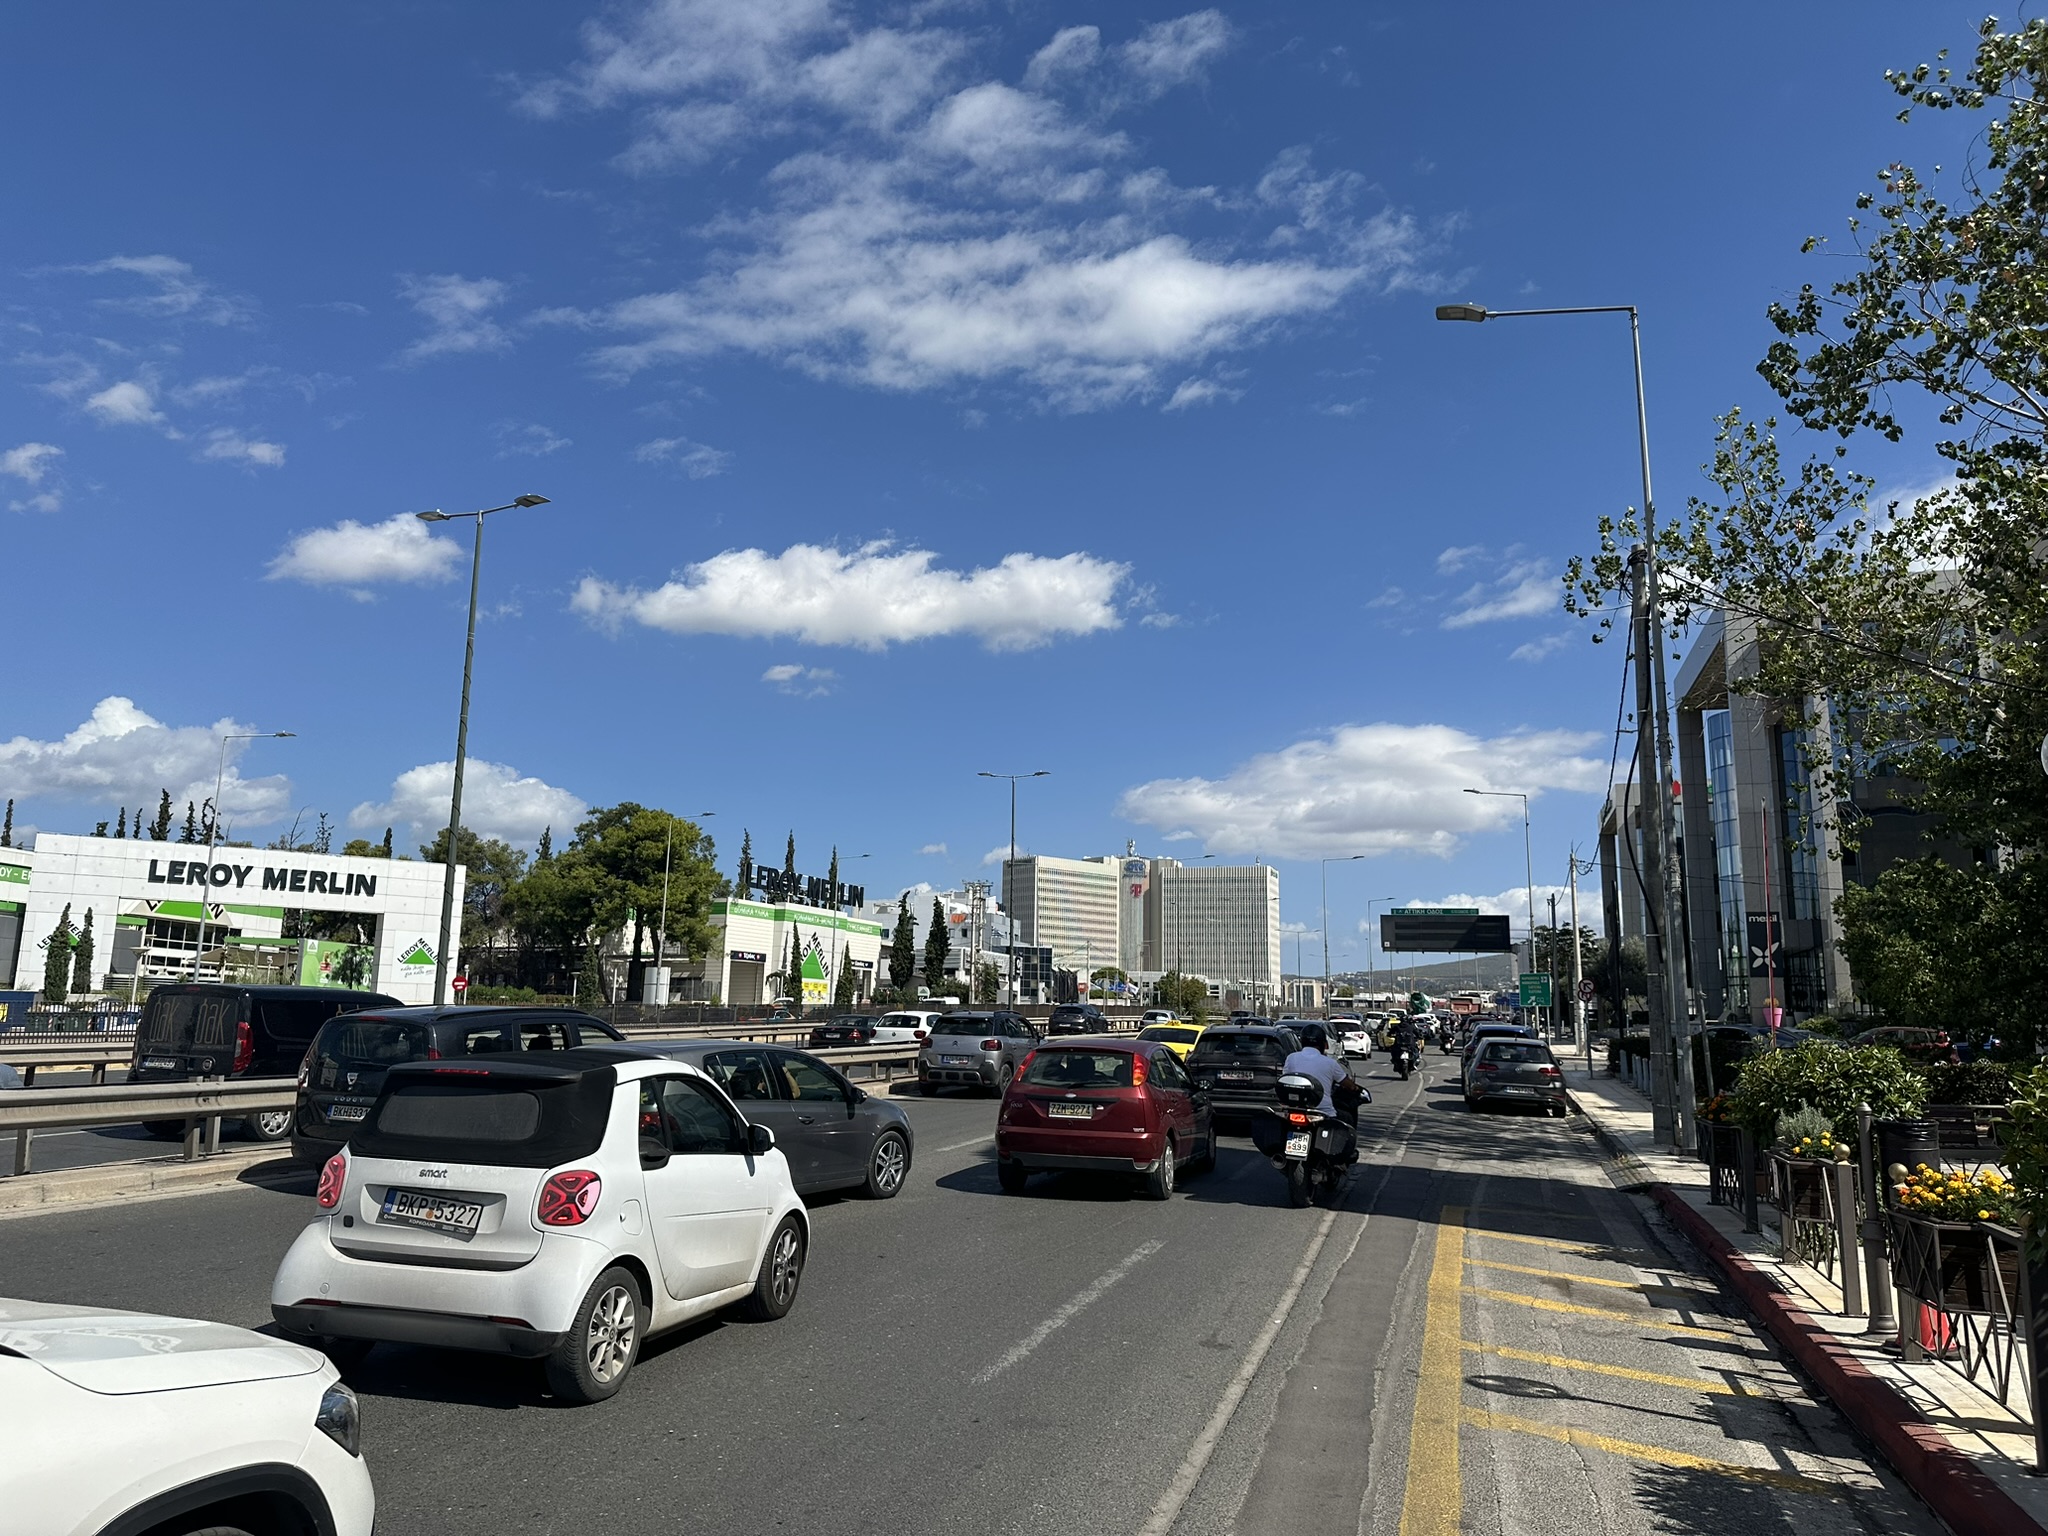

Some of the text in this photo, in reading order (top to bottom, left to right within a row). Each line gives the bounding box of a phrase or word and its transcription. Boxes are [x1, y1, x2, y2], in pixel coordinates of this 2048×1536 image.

[148, 859, 377, 897] LEROY MERLIN
[746, 862, 803, 894] LEROY
[397, 942, 420, 963] LEROY
[811, 931, 830, 978] MERLIN
[419, 1169, 448, 1179] smart
